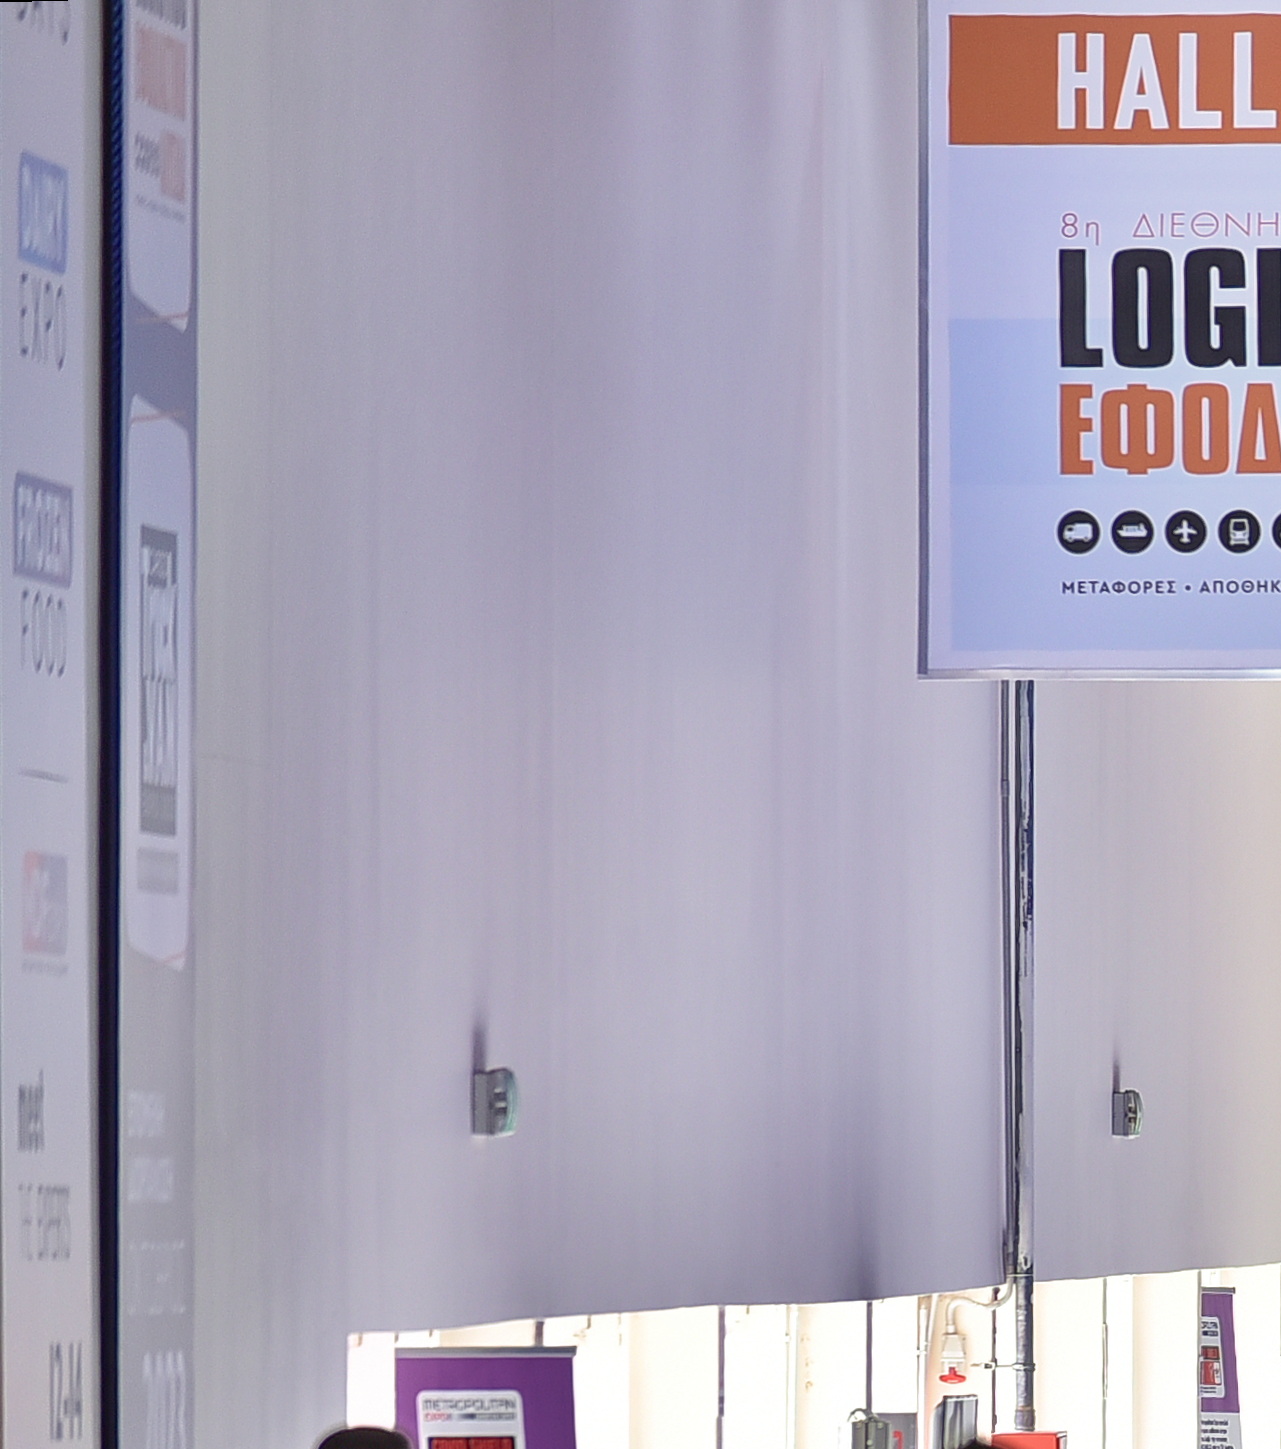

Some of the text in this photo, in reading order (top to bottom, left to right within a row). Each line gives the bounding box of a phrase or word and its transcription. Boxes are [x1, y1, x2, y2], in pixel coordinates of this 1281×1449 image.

[1056, 32, 1278, 130] HALL
[1060, 212, 1100, 245] 8η
[1061, 580, 1177, 595] ΜΕΤΑΦΟΡΕΣ
[20, 589, 67, 677] FOOD
